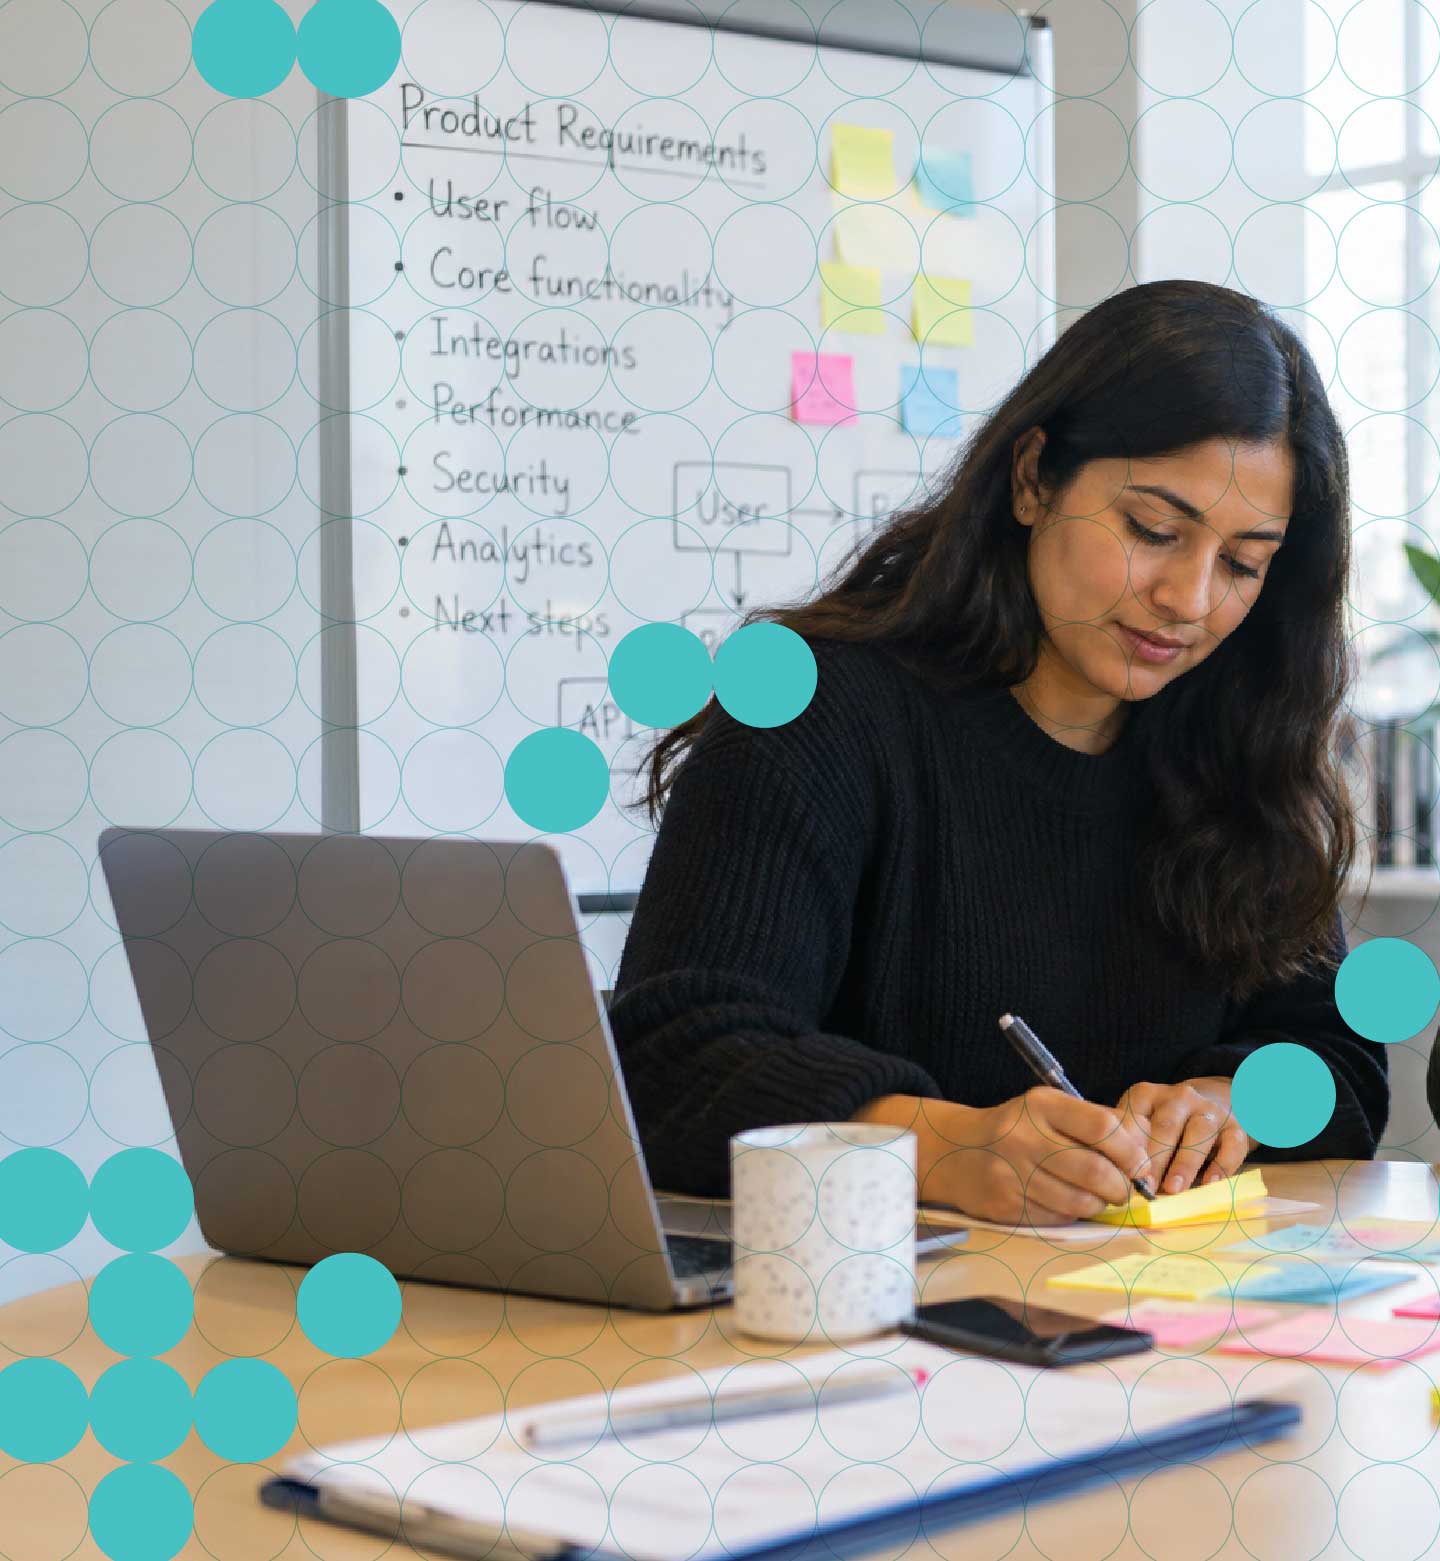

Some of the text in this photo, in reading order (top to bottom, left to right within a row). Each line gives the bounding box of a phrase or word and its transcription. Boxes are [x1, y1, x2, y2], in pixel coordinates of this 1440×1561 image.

[400, 83, 768, 175] Product Requirements
[430, 178, 599, 232] User flow
[430, 247, 734, 330] Core functionality
[430, 316, 638, 378] Integrations
[432, 382, 641, 434] Performance
[432, 451, 570, 515] Security
[697, 490, 768, 526] User
[431, 521, 594, 583] Analytics
[434, 595, 610, 652] Next steps
